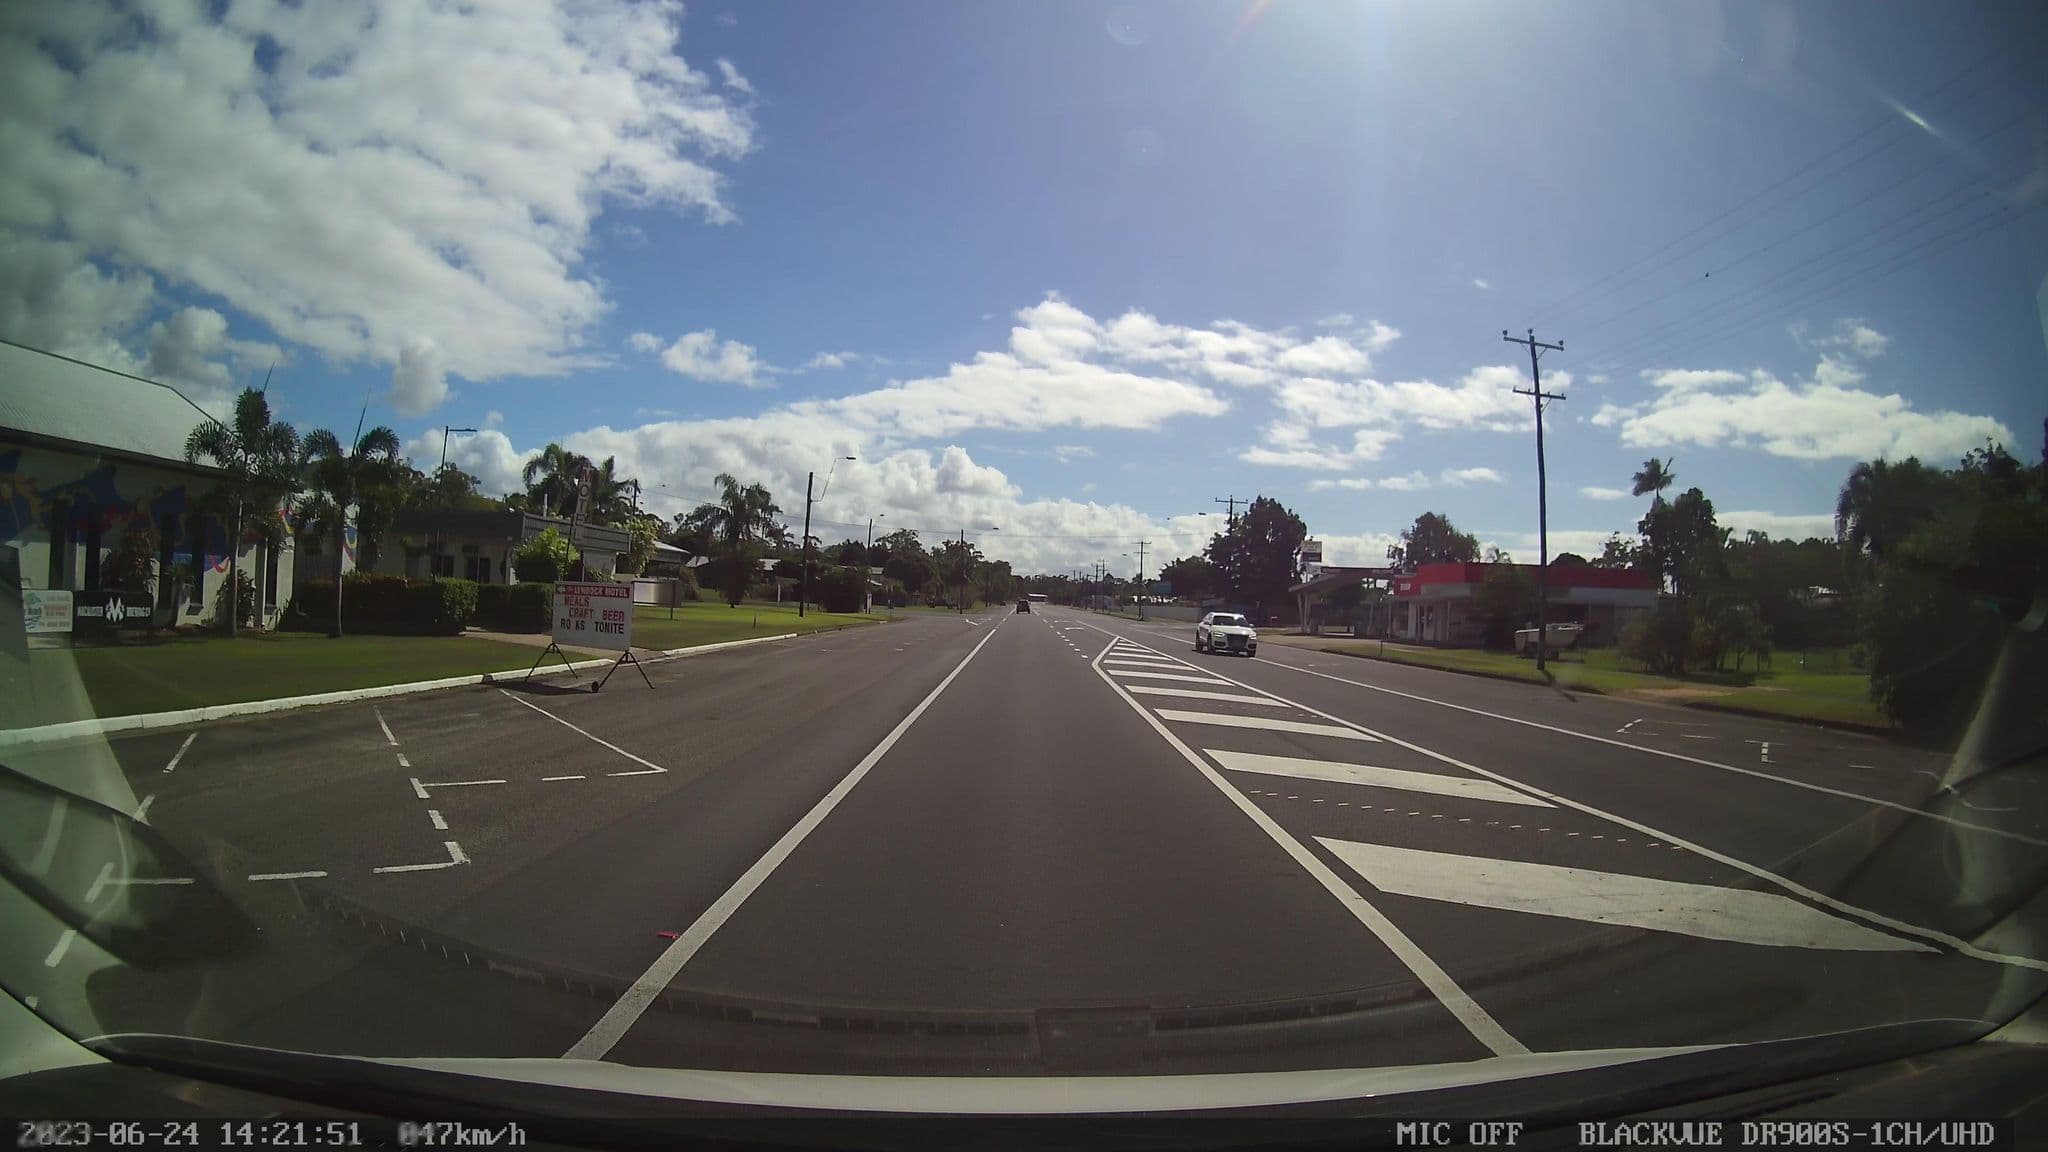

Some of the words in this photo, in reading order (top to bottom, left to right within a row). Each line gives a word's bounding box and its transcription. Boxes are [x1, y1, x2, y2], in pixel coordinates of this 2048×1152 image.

[605, 587, 629, 598] MOTEL
[564, 596, 590, 607] MEALS
[569, 607, 594, 619] CRAFT
[602, 609, 625, 622] BEER
[594, 621, 625, 635] TONITE
